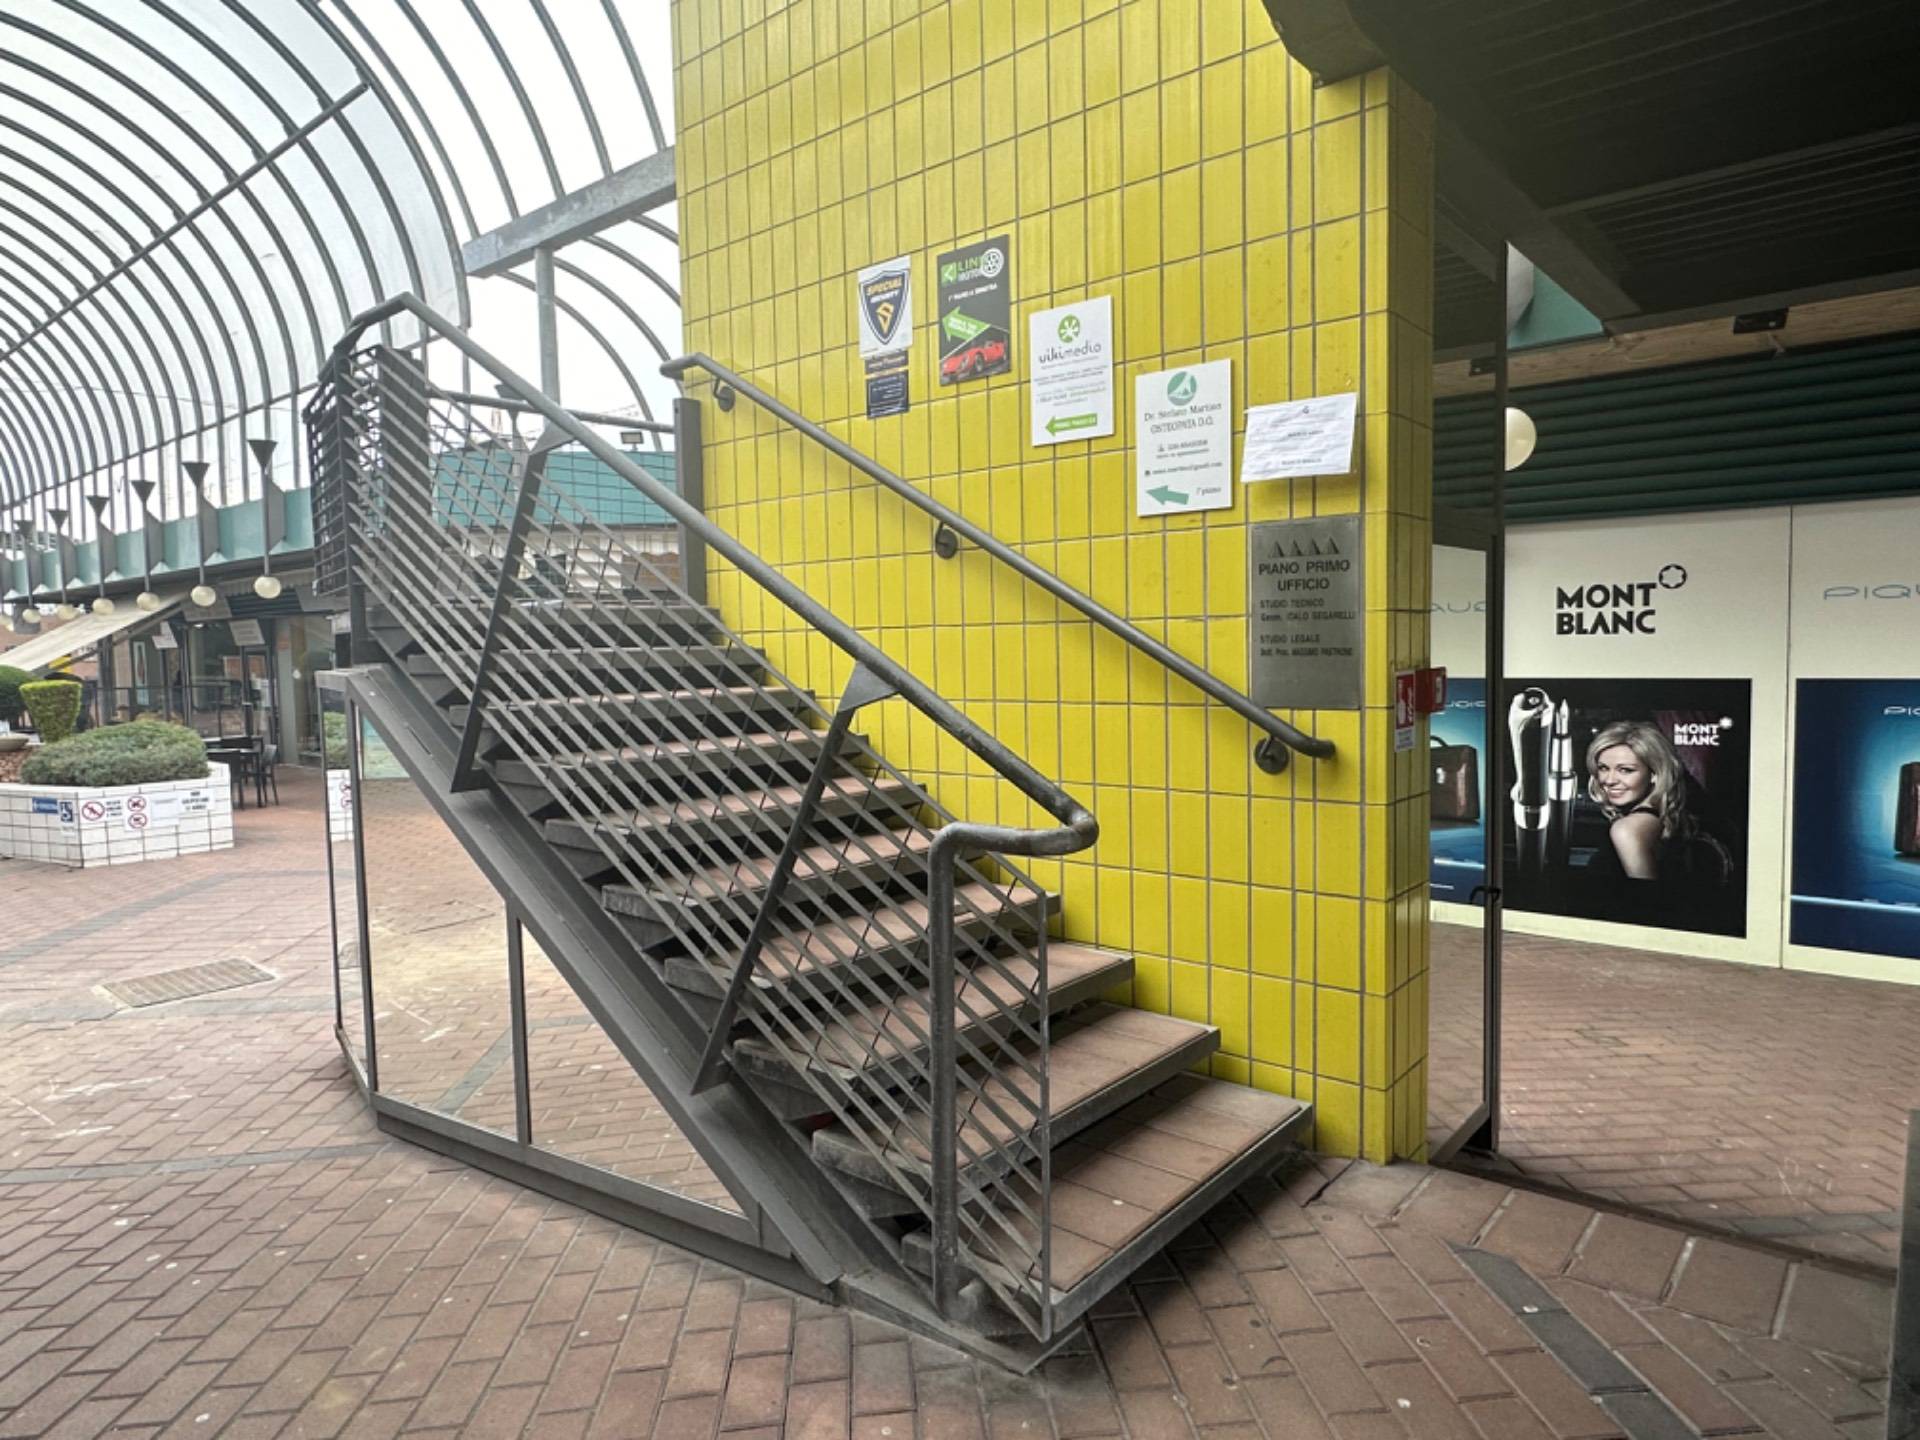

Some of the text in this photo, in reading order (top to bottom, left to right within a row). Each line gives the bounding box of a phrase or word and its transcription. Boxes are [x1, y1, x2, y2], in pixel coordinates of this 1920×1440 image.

[1259, 559, 1351, 576] PIANO PRIMO
[1278, 577, 1330, 592] UFFICIO
[1556, 582, 1657, 609] MONT
[1260, 597, 1324, 609] STUDIO TECNICO
[1556, 609, 1656, 635] BLANC
[1260, 633, 1320, 644] STUDIO LEGALE
[1674, 722, 1720, 735] MONT
[1674, 734, 1720, 747] BLANC
